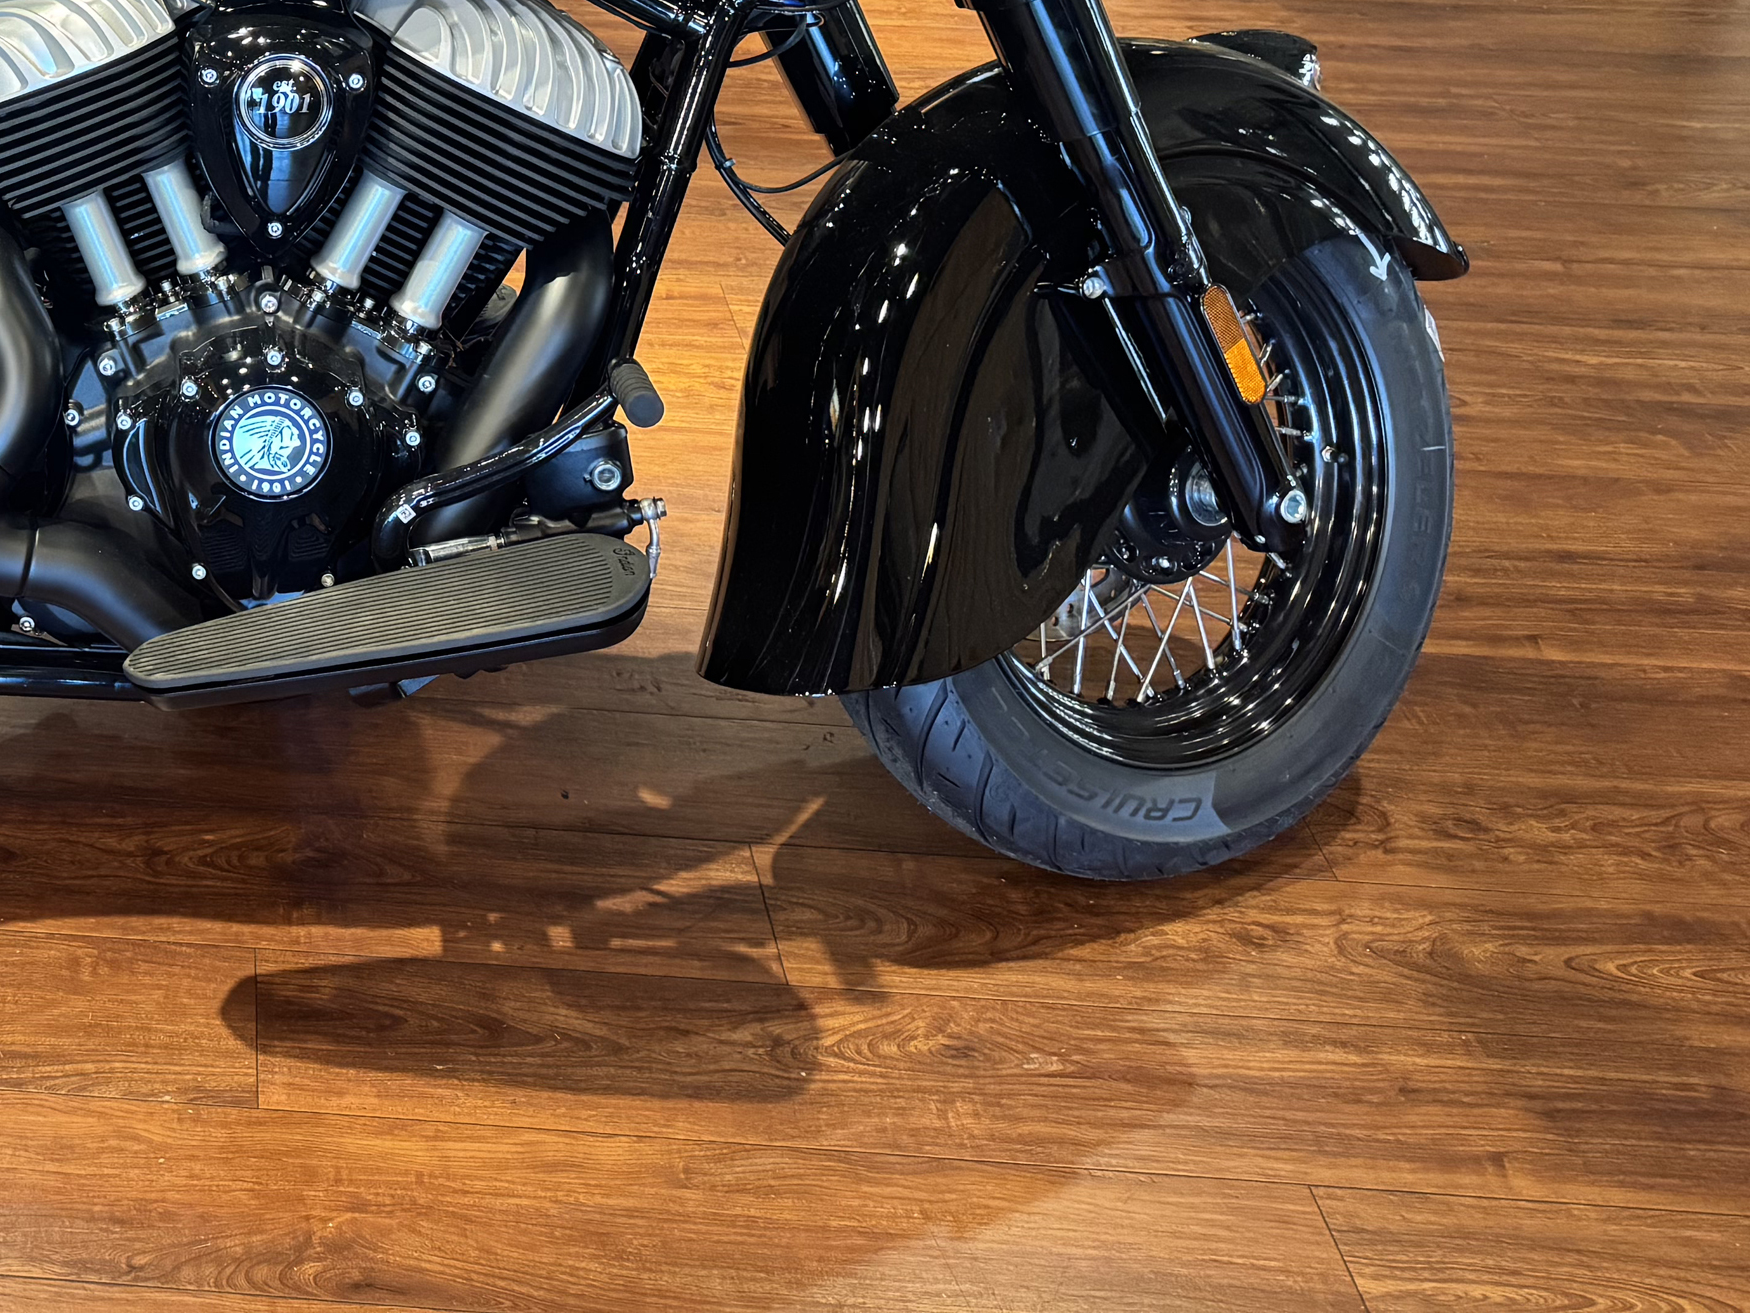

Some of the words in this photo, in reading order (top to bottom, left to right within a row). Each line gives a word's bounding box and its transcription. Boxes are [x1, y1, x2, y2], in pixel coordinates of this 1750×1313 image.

[256, 92, 311, 114] 1901
[219, 404, 244, 474] INDIAN
[247, 392, 324, 476] MOTORCYCLE
[251, 479, 292, 493] 1901
[612, 547, 636, 577] Indian
